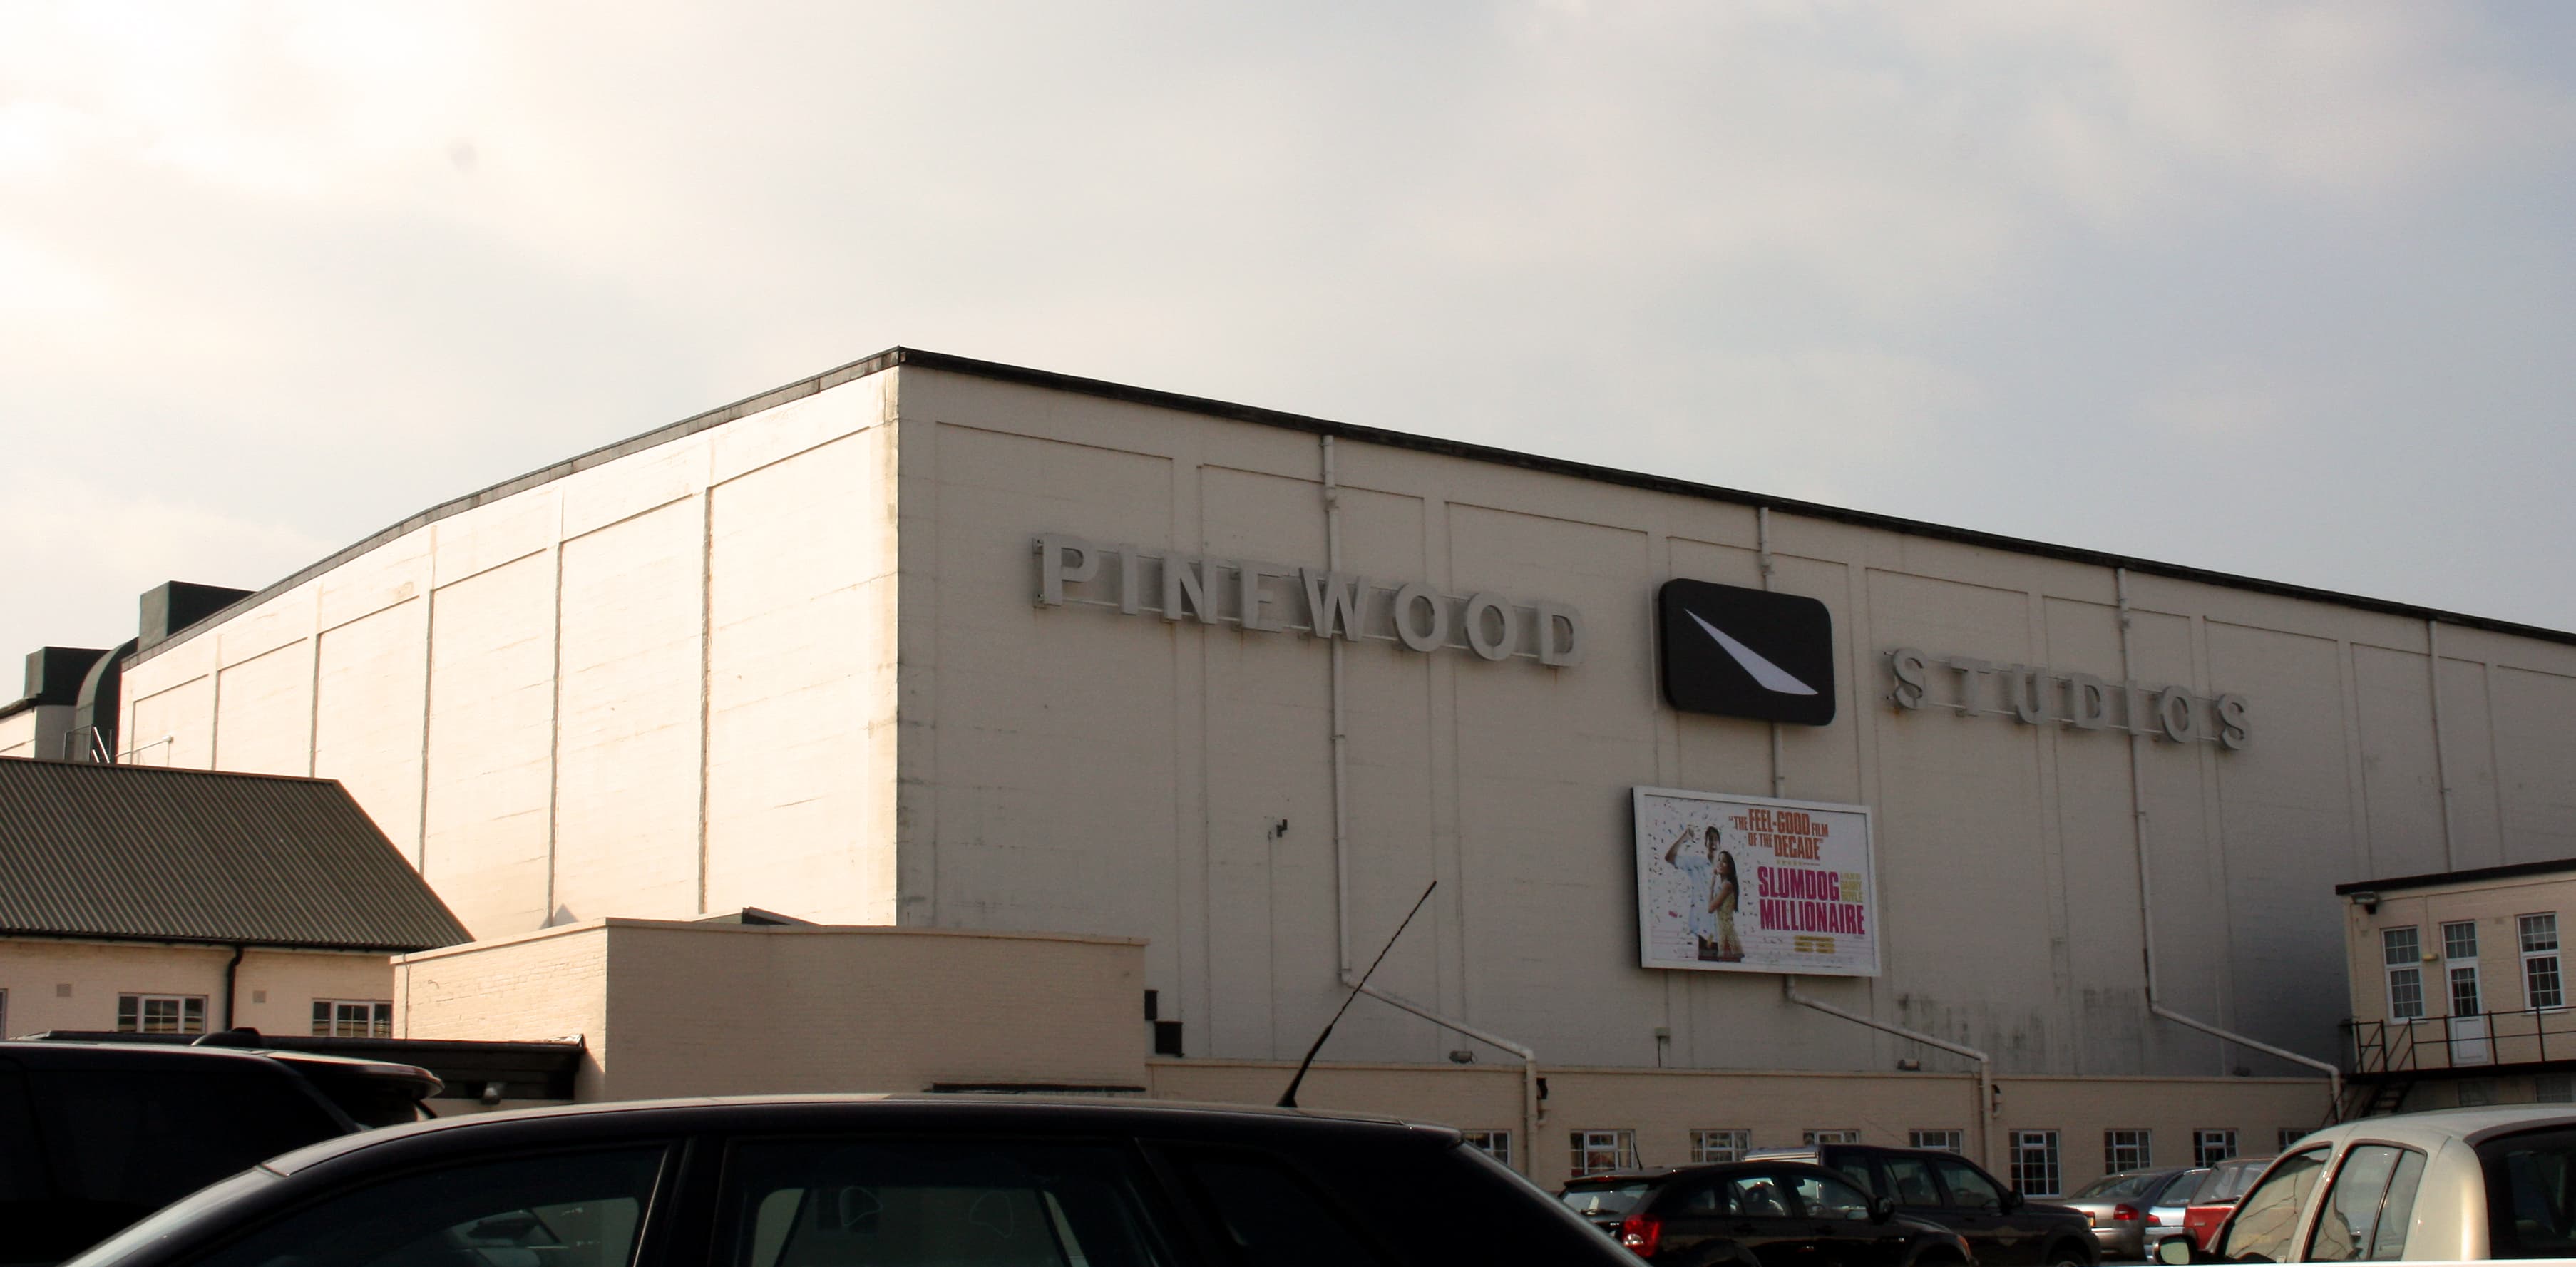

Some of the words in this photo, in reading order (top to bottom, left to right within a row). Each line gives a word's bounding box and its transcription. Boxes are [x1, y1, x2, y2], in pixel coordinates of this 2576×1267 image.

[1042, 532, 1584, 667] PINEWOOD
[1891, 647, 2252, 751] STUDIOS
[1748, 809, 1810, 835] FEEL-GOOD
[1812, 823, 1828, 837] FILM
[1748, 833, 1757, 846] OF
[1760, 833, 1772, 847] THE
[1757, 866, 1839, 901] SLUMDOG
[1760, 899, 1865, 934] MILLIONAIRE
